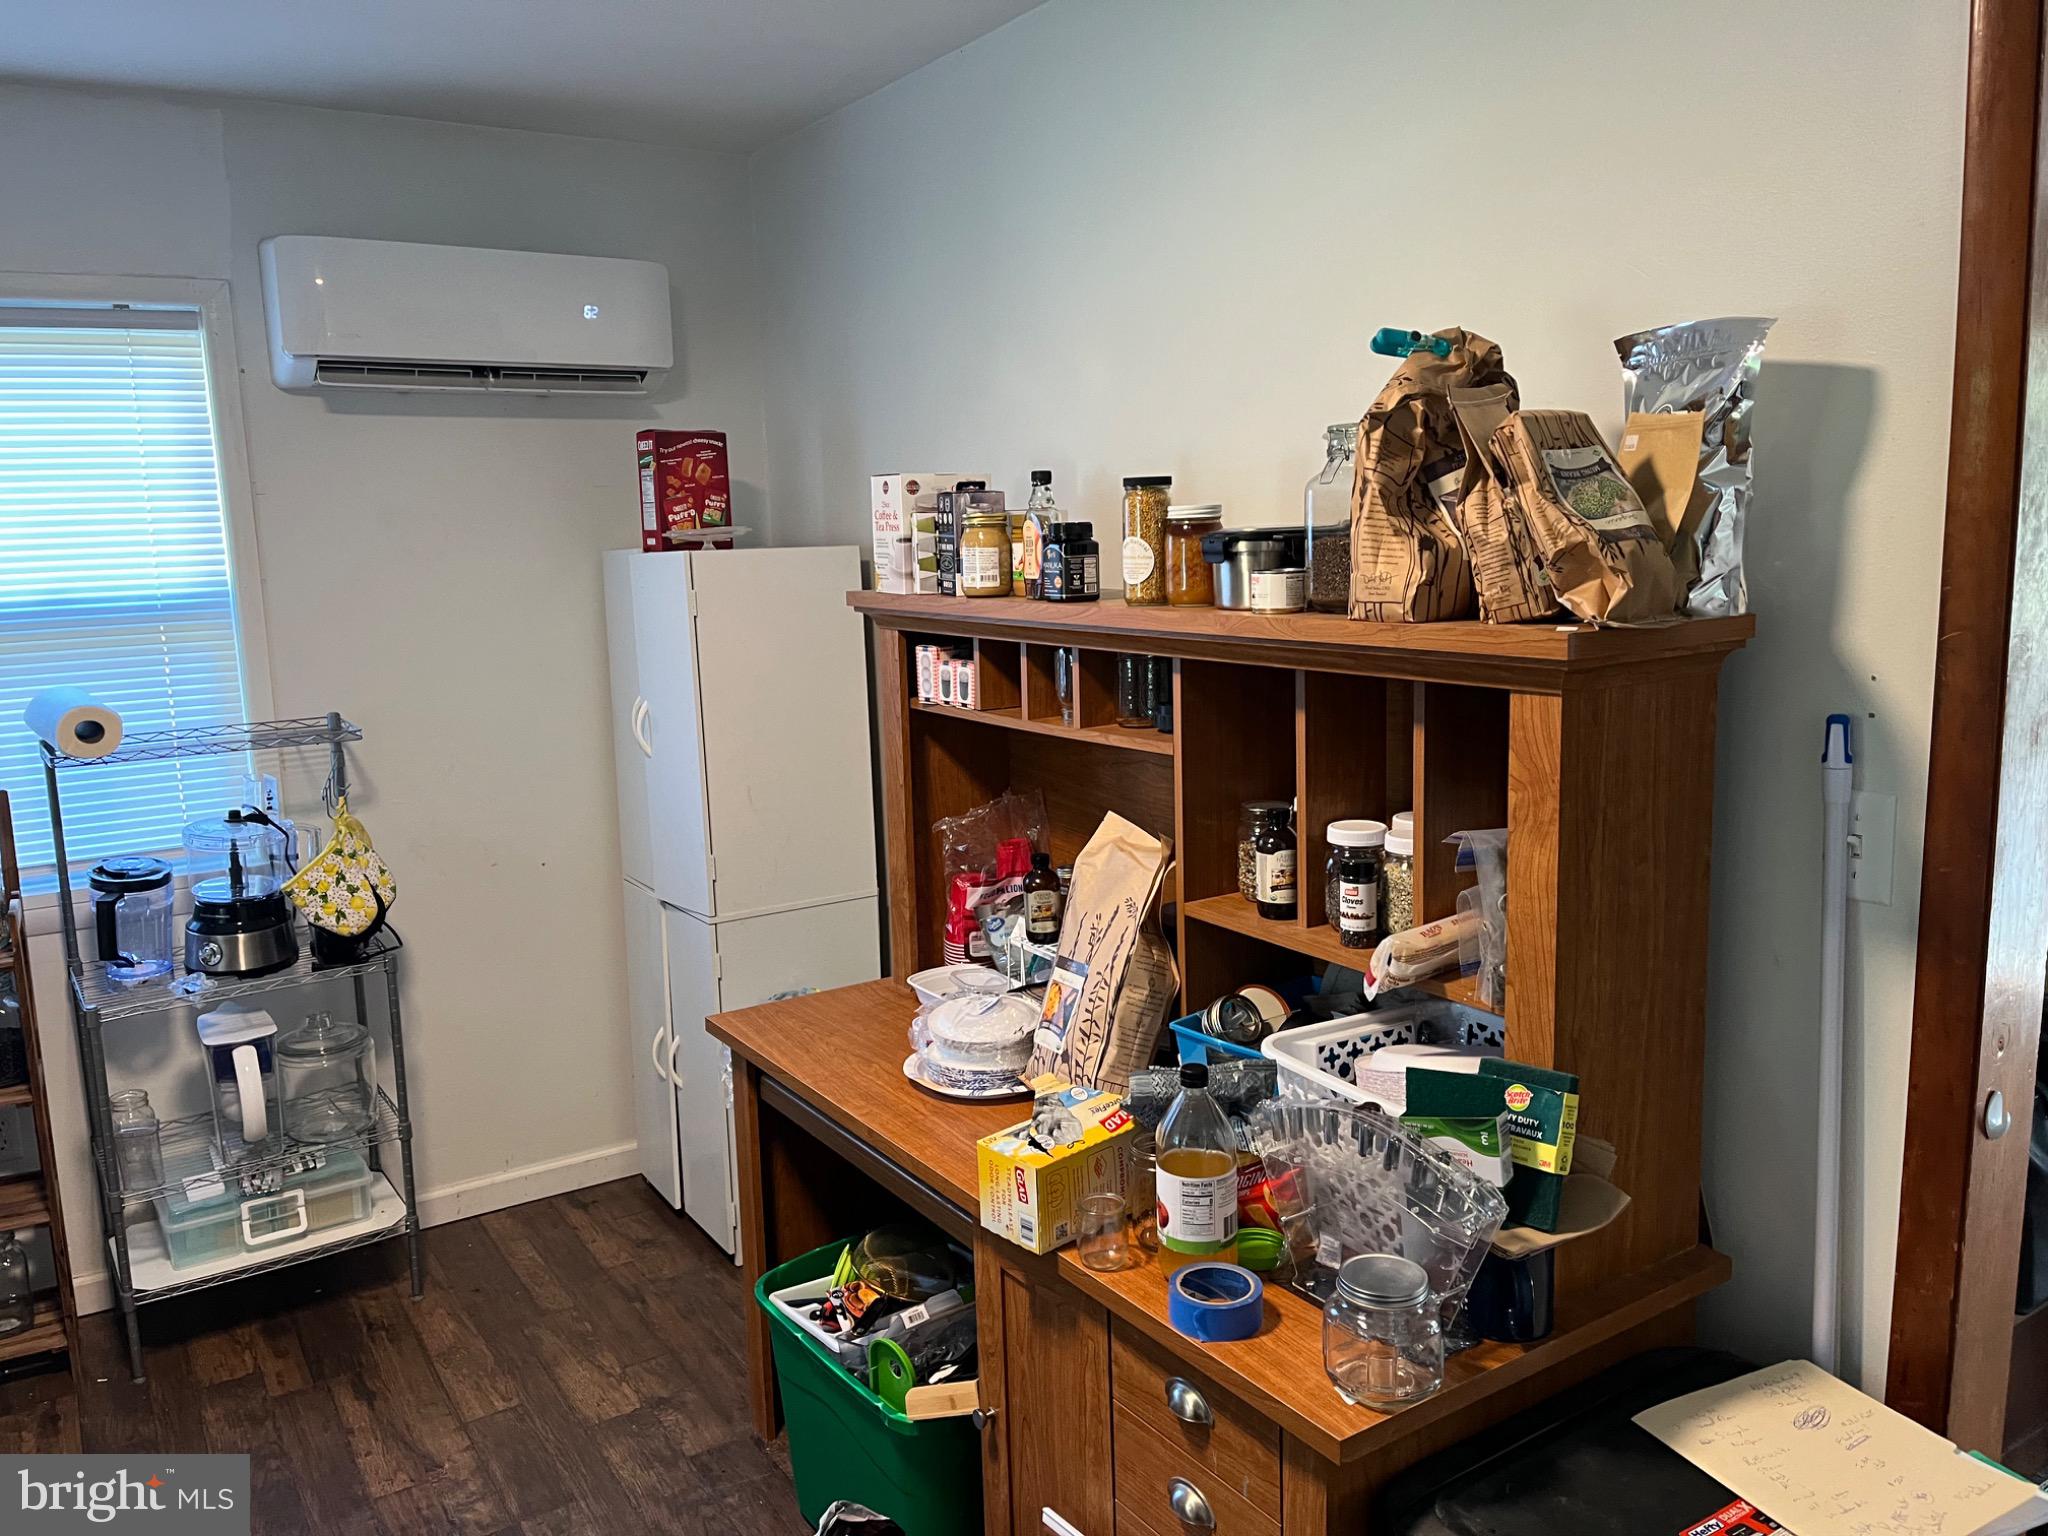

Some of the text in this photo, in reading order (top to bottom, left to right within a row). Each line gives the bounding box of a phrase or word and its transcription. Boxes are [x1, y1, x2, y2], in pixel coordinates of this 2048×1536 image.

[583, 304, 599, 319] 62
[874, 509, 899, 520] Coffee &
[875, 522, 900, 532] Tea Press
[1005, 883, 1024, 894] LION
[1342, 895, 1364, 905] Cloves
[1104, 1108, 1134, 1131] LAD
[1517, 1115, 1540, 1128] DUTY
[1562, 1121, 1576, 1130] 100
[1480, 1135, 1489, 1146] 3
[1539, 1160, 1551, 1169] 3M
[1015, 1168, 1028, 1204] GLAD
[1691, 1521, 1722, 1536] Hefty
